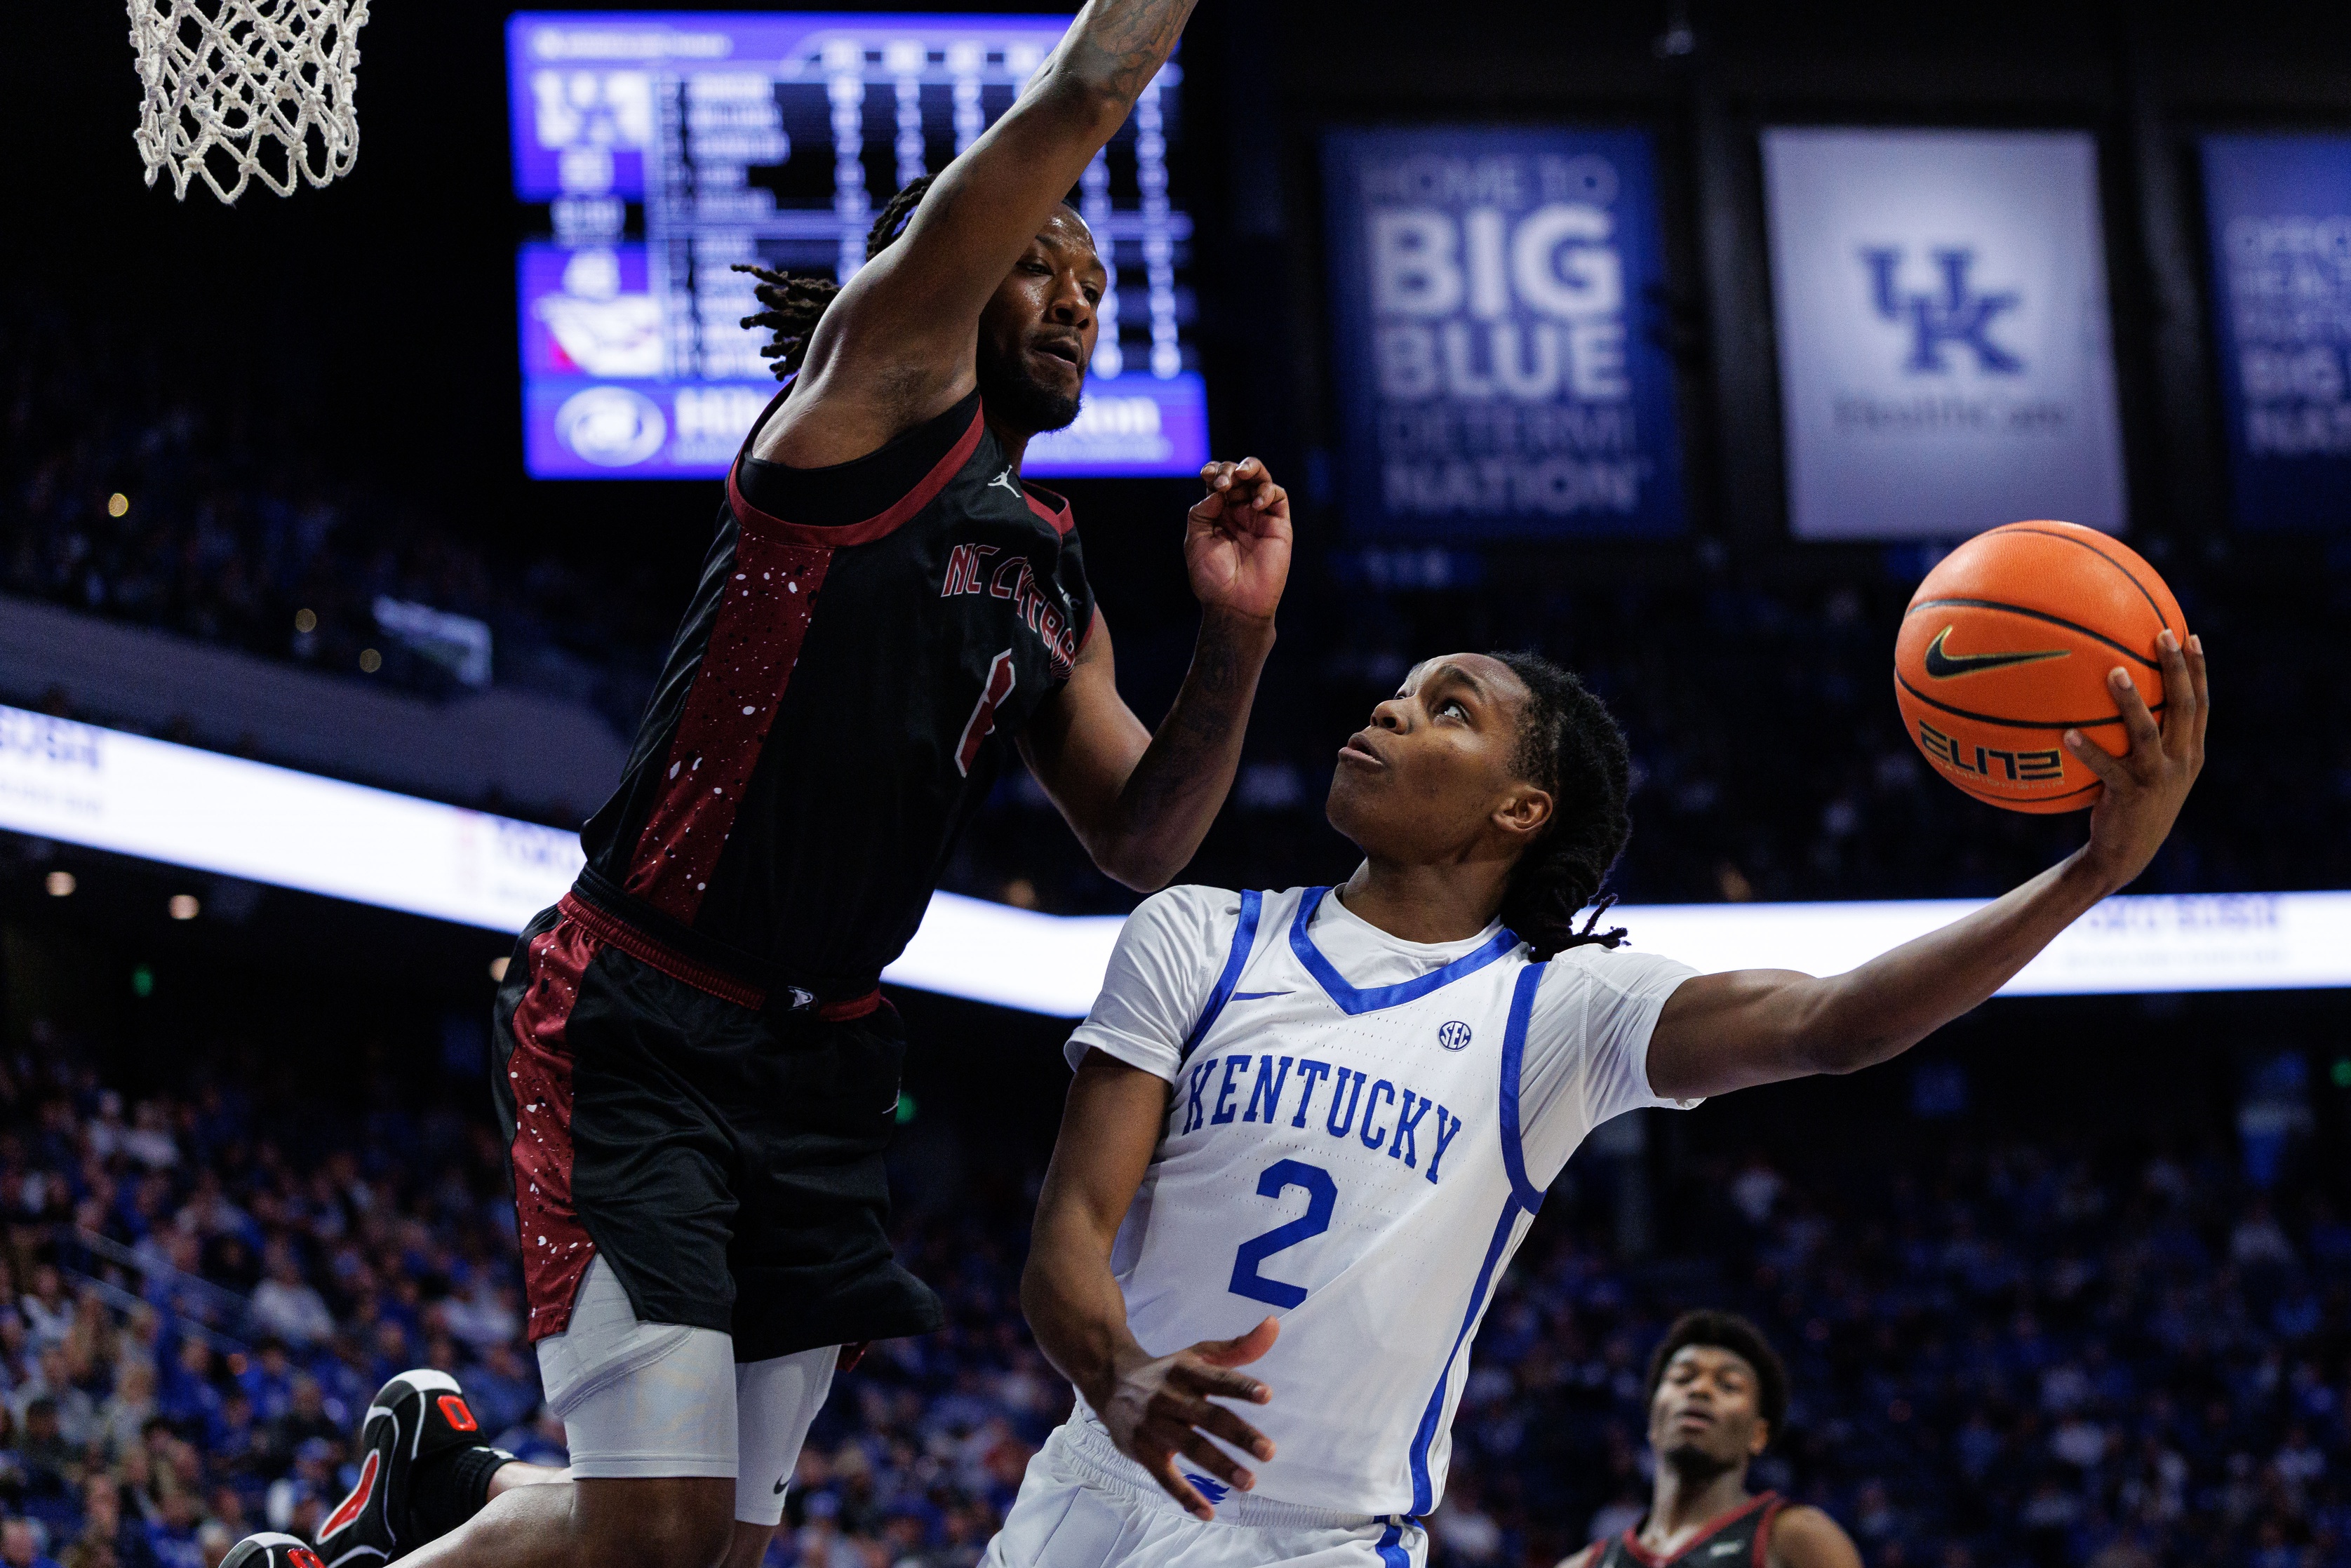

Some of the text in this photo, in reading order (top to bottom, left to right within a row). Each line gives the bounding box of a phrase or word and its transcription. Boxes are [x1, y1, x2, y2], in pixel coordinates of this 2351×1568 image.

[1541, 157, 1614, 203] TO
[1372, 206, 1621, 317] BIG
[1858, 244, 2024, 375] UK
[1378, 323, 1628, 398] BLUE
[941, 543, 1000, 598] NC
[1440, 1021, 1471, 1049] SEC
[1182, 1054, 1461, 1184] KENTUCKY
[1228, 1158, 1338, 1310] 2
